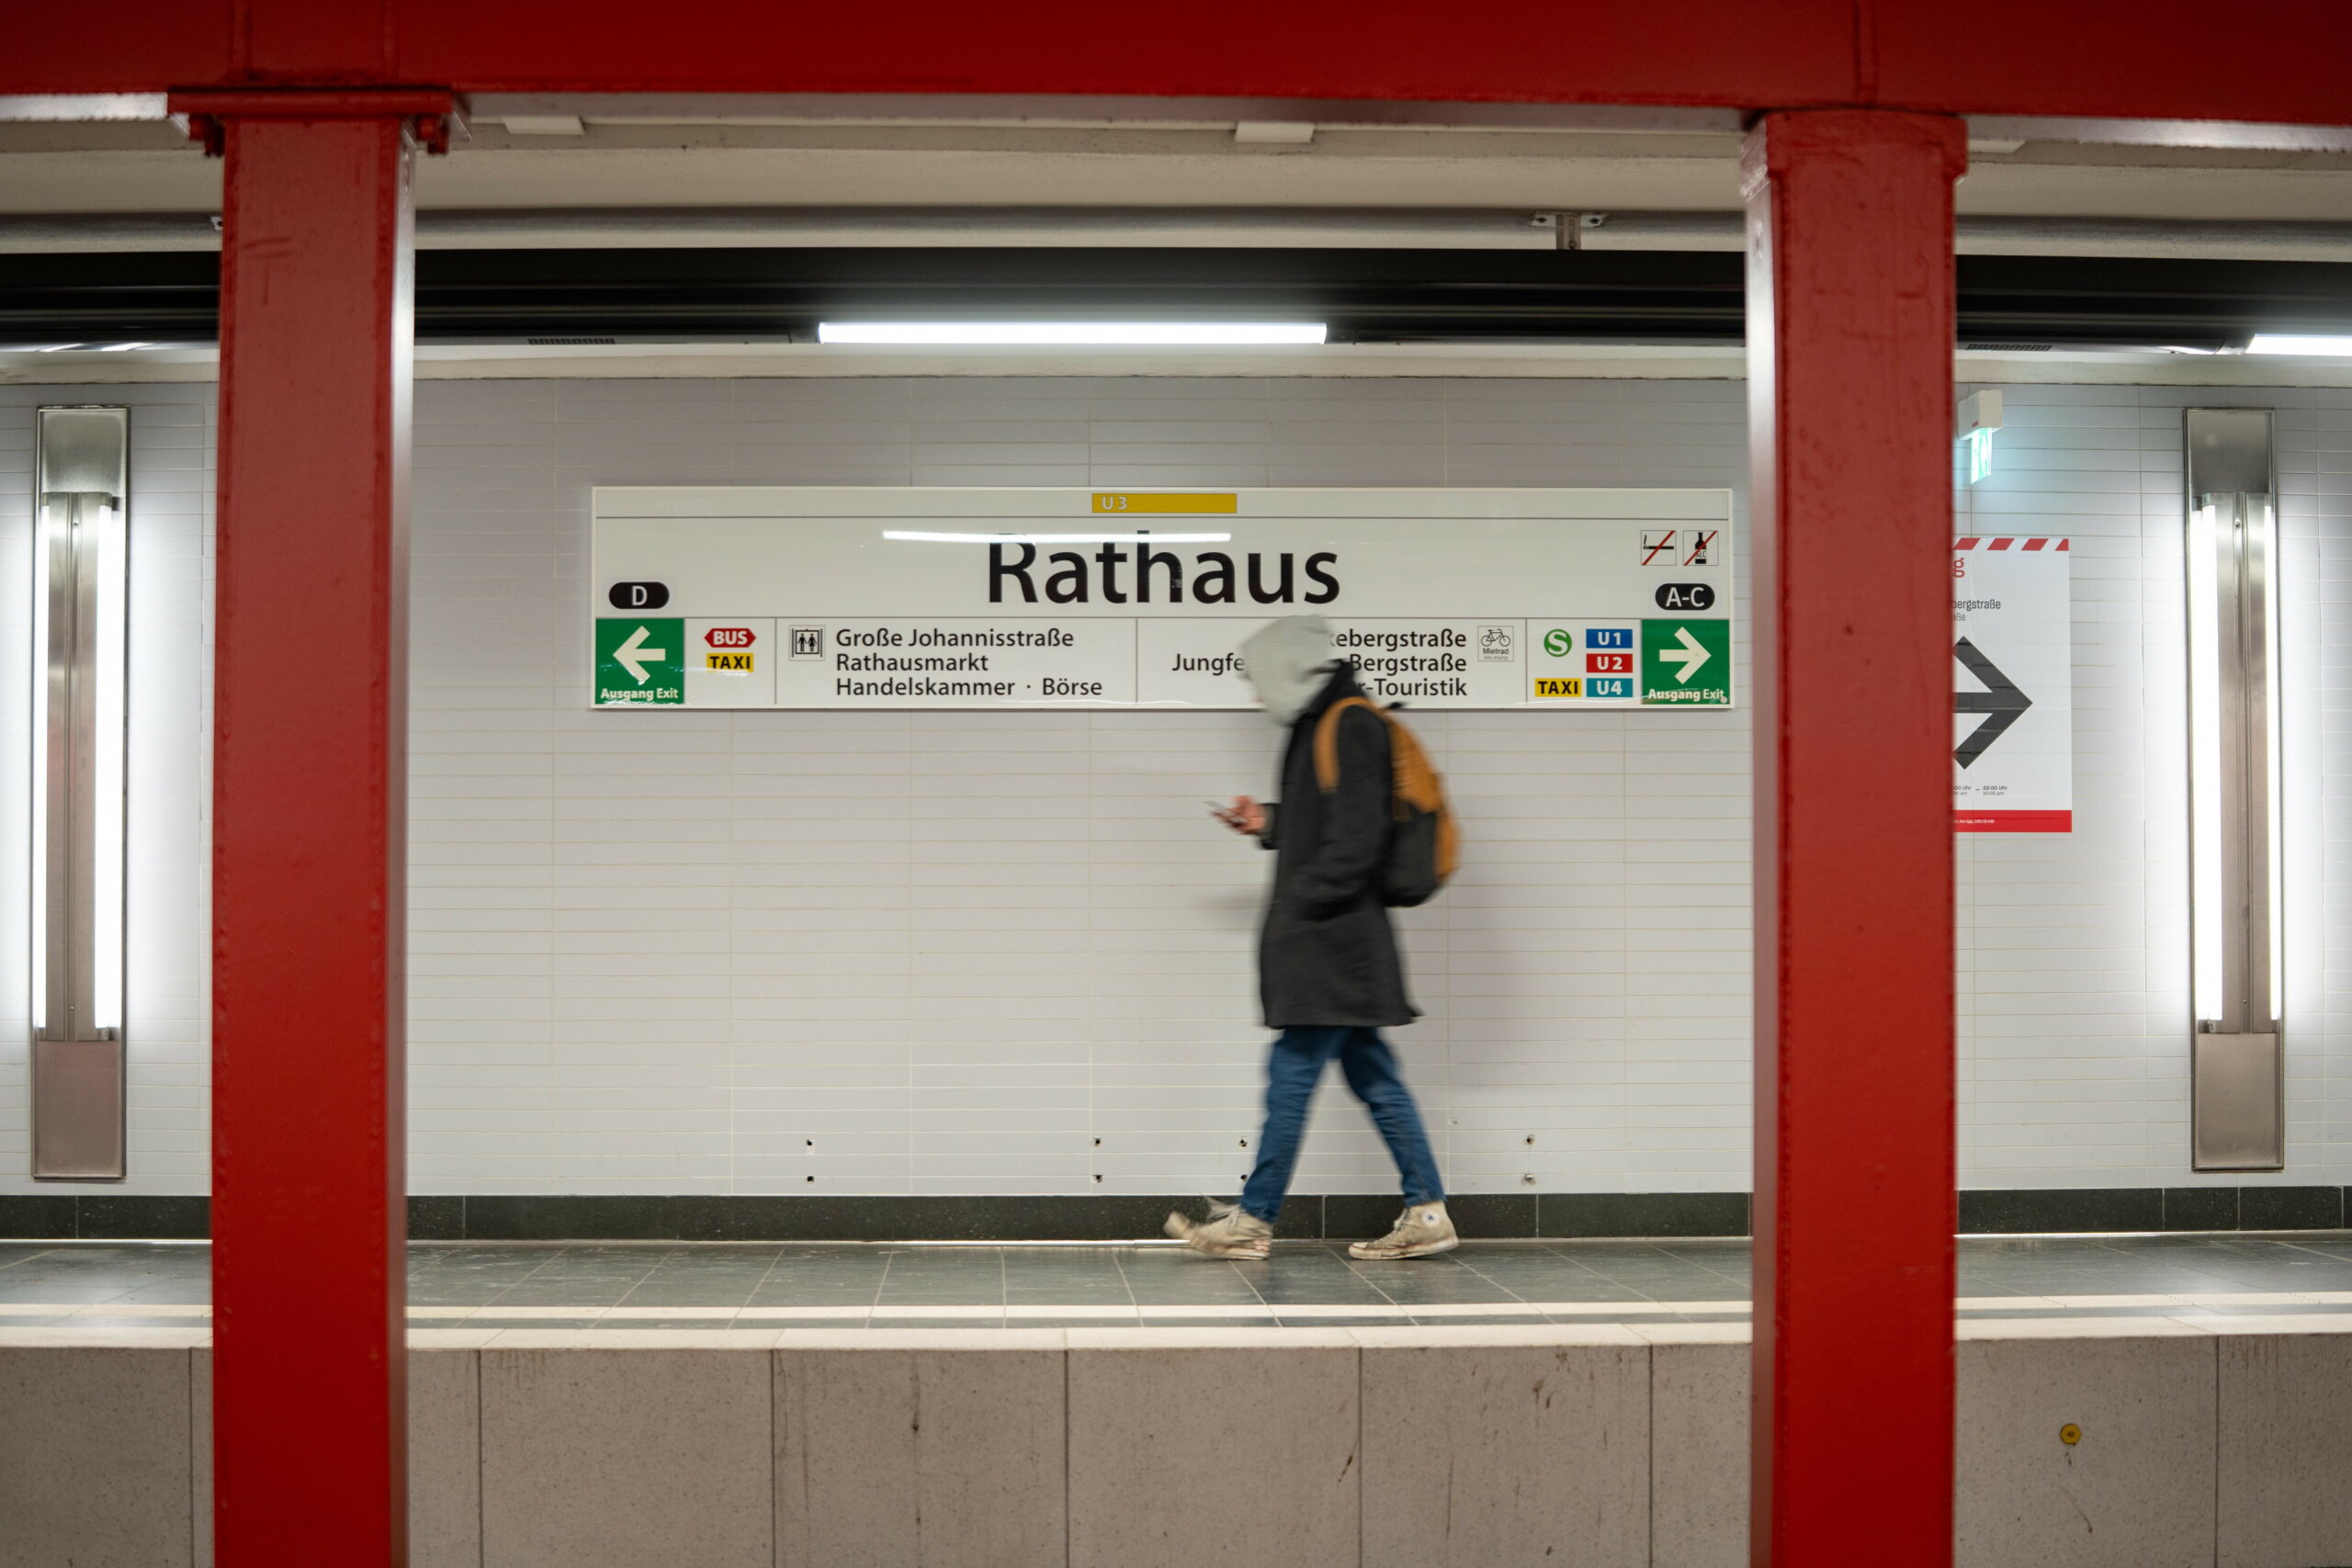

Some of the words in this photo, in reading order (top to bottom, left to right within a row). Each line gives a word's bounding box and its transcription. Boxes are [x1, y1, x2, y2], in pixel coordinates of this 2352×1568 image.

[989, 530, 1340, 604] Rathaus
[631, 585, 648, 606] D
[1665, 586, 1705, 607] A-C
[712, 630, 749, 646] BUS
[836, 627, 903, 648] Große
[909, 627, 1074, 648] Johannisstraße
[709, 656, 752, 670] TAXI
[836, 652, 989, 671] Rathausmarkt
[1171, 652, 1246, 676] Jungfe
[1349, 652, 1467, 677] Bergstraße
[600, 688, 654, 704] Ausgang
[656, 688, 679, 699] Exit
[836, 677, 1015, 696] Handelskammer
[1042, 677, 1103, 696] Börse
[1357, 678, 1468, 696] r-Touristik
[1537, 681, 1579, 694] TAXI
[1647, 688, 1701, 702] Ausgang
[1702, 688, 1725, 699] Exit
